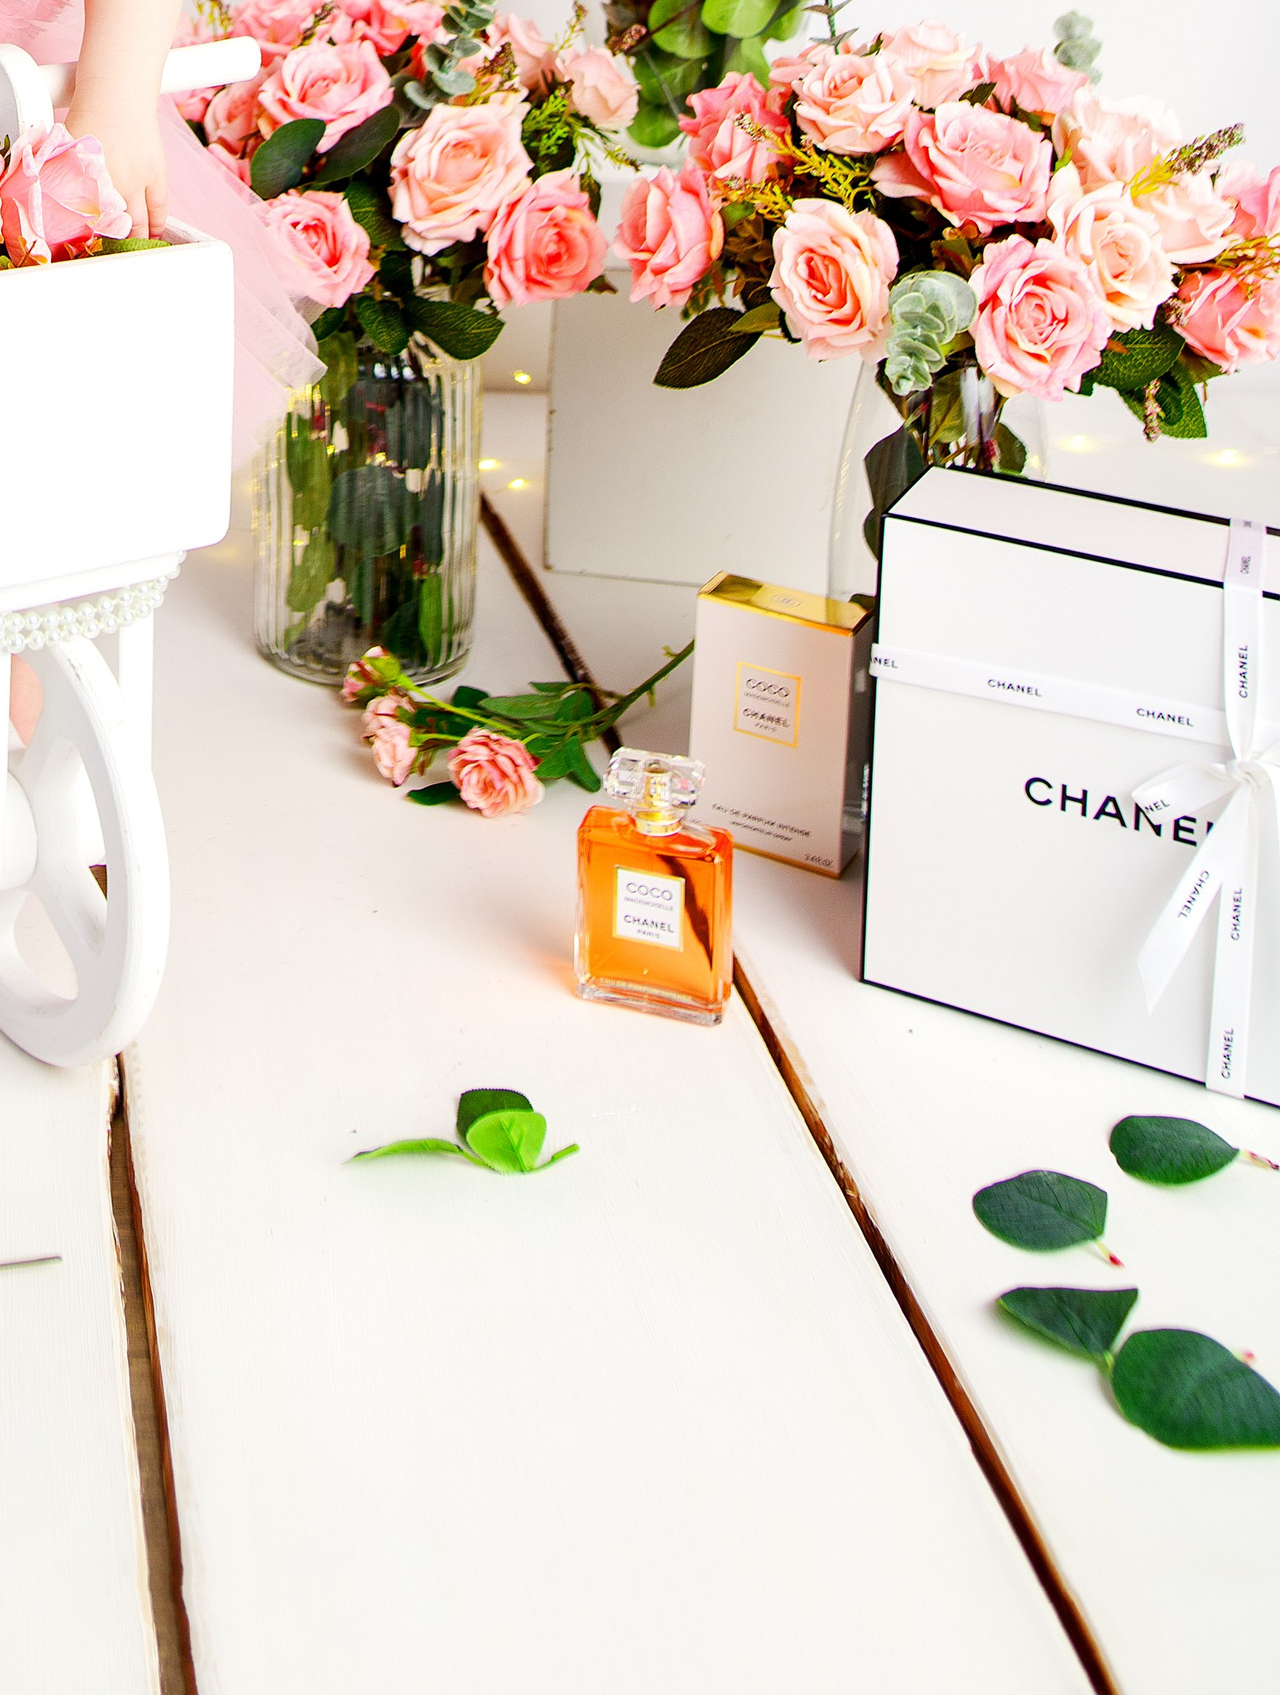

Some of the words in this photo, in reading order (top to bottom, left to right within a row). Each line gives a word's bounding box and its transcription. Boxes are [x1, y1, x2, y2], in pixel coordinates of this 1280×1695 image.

[745, 678, 790, 698] COCO
[1239, 645, 1248, 699] CHANEL
[743, 708, 790, 728] CHANEL
[987, 679, 1042, 697] CHANEL
[1136, 708, 1194, 727] CHANEL
[1024, 777, 1214, 847] CHANE
[626, 882, 673, 901] COCO
[1178, 870, 1210, 919] CHANEL
[1231, 887, 1242, 941] CHANEL
[623, 914, 674, 933] CHANEL
[1221, 1028, 1234, 1079] CHANEL
